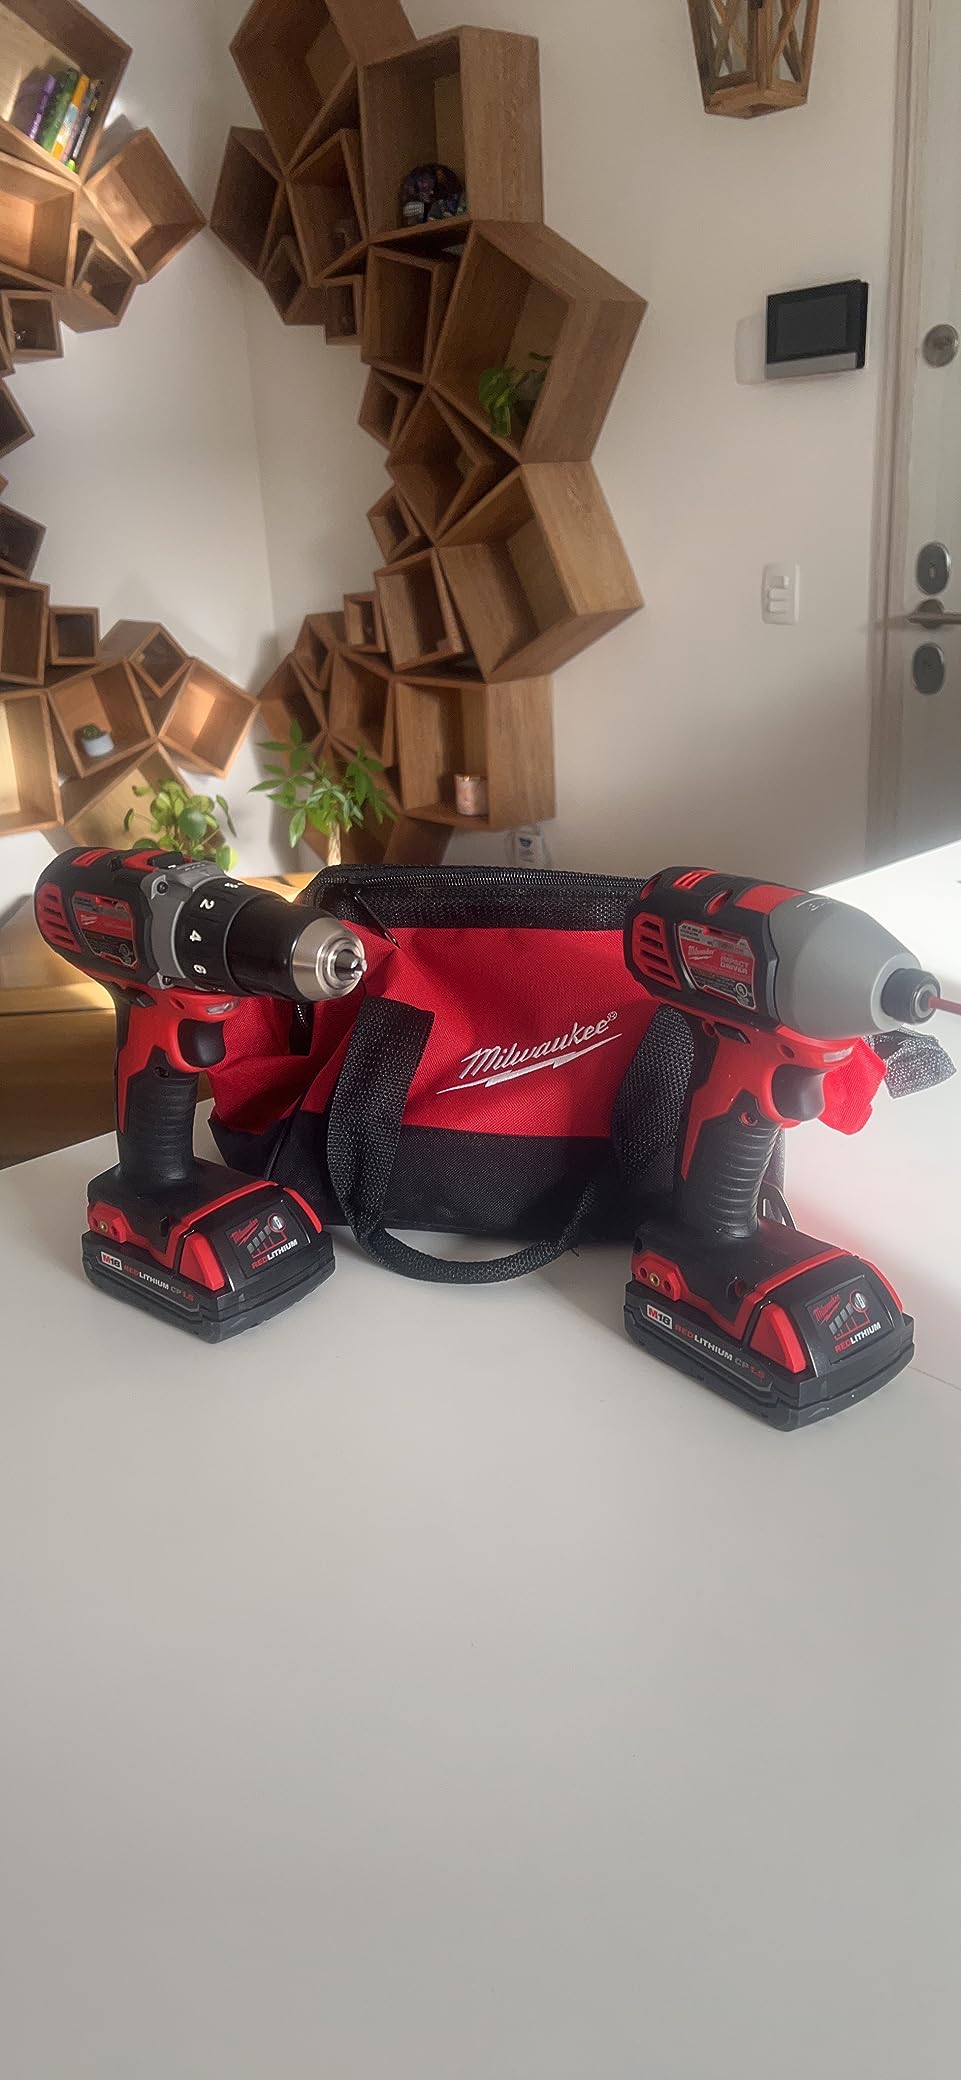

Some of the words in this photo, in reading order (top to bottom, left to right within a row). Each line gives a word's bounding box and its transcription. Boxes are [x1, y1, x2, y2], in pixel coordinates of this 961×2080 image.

[200, 898, 215, 910] 2
[189, 929, 202, 942] 4
[193, 964, 207, 975] 6
[251, 1238, 298, 1269] REDLITHIUM
[102, 1252, 121, 1269] M18
[123, 1263, 169, 1290] REDLITHIUM
[648, 1306, 672, 1328] M18
[674, 1323, 733, 1361] REDLITHIUM
[834, 1321, 882, 1353] REDLITHIUM
